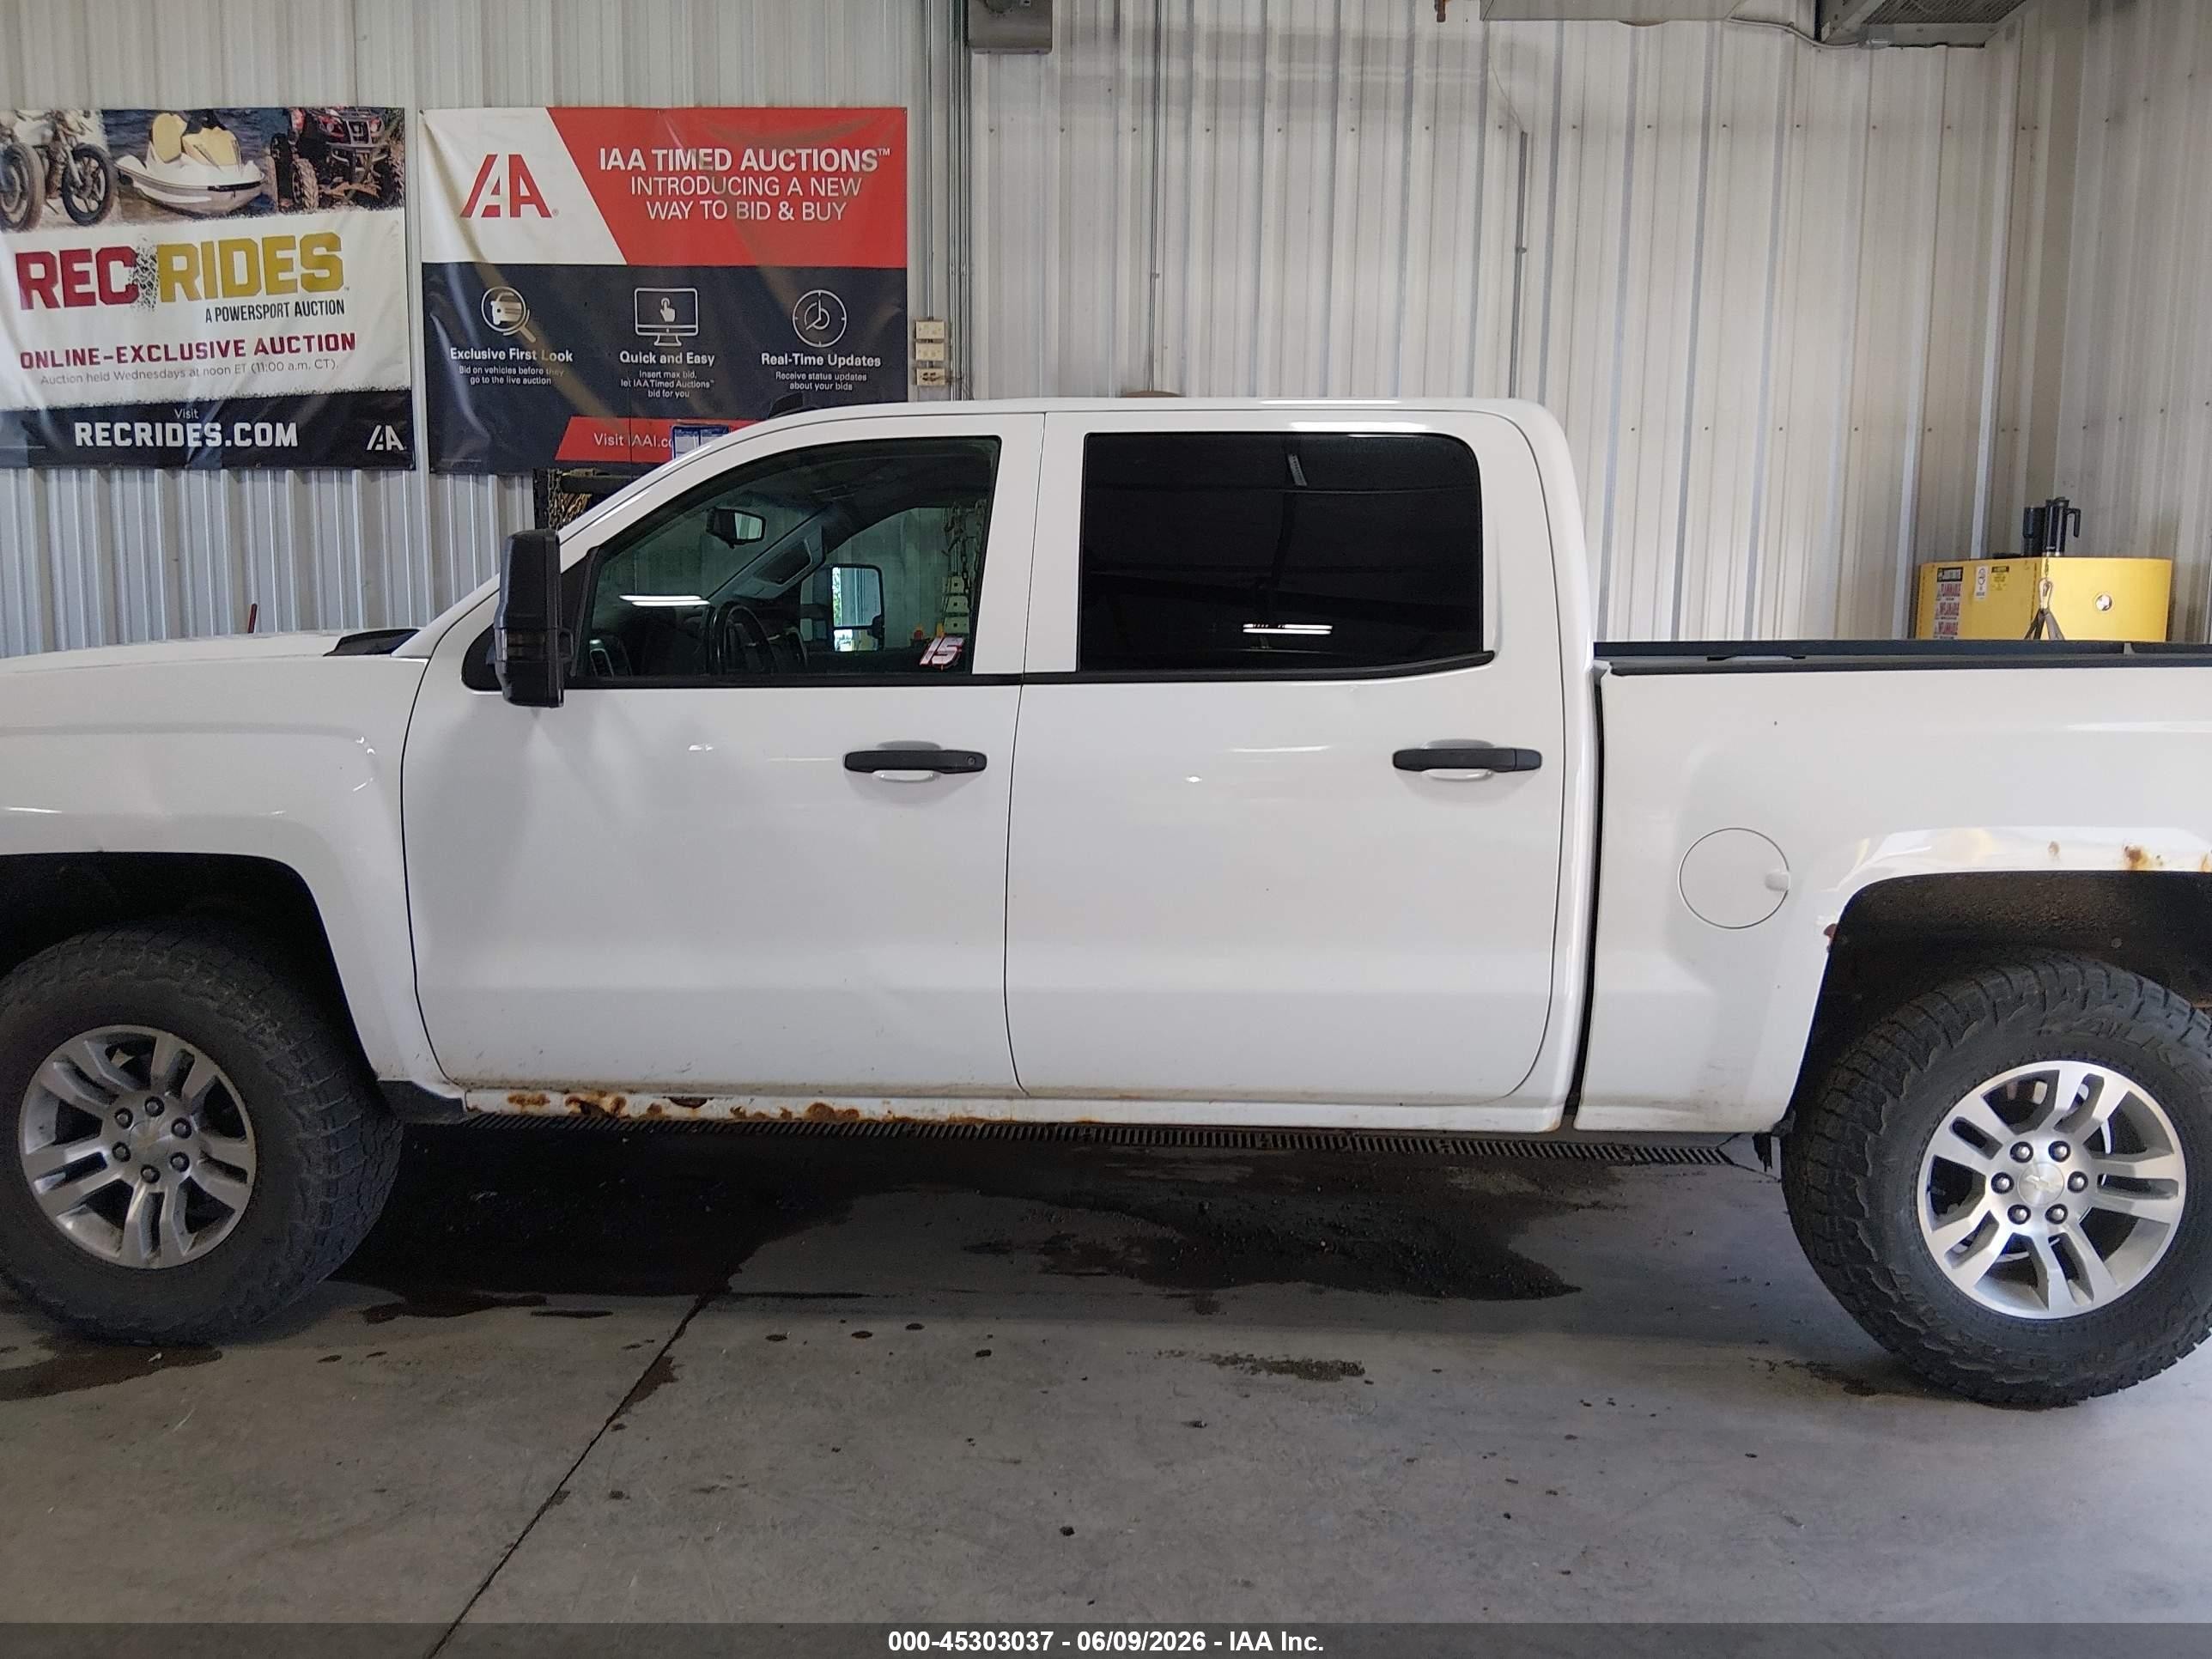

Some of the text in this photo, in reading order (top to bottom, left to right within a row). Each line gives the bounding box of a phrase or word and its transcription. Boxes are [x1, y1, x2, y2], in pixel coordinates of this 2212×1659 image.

[600, 148, 646, 171] IAA
[652, 149, 732, 172] TIMED
[631, 176, 861, 197] INTRODUCING A NEW
[647, 200, 847, 221] WAY TO BID & BUY
[15, 232, 343, 310] REC RIDES
[205, 299, 344, 323] A POWERSPORT AUCTION
[20, 332, 356, 369] ONLINE-EXCLUSIVE AUCTION
[450, 348, 573, 362] Exclusive First Look
[619, 350, 715, 367] Quick and Easy
[761, 353, 881, 368] Real-Time Updates
[41, 374, 83, 386] Auction
[87, 371, 110, 383] held
[113, 368, 186, 381] Wednesdays
[189, 368, 199, 378] at
[204, 367, 231, 377] noon
[234, 364, 246, 374] ET
[251, 362, 284, 374] (11:00
[459, 365, 471, 374] Bid
[484, 365, 516, 375] vehicles
[519, 366, 544, 375] before
[639, 369, 661, 379] Insert
[775, 371, 867, 382] Receive status updates
[470, 376, 480, 386] go
[492, 375, 504, 384] the
[507, 375, 520, 385] live
[523, 376, 551, 385] auction
[633, 379, 649, 387] IAA
[650, 379, 674, 388] Timed
[789, 381, 853, 392] about your bids
[647, 389, 660, 398] bid
[662, 389, 672, 398] for
[174, 408, 198, 420] Visit
[75, 421, 298, 447] RECRIDES.COM
[593, 432, 624, 447] Visit
